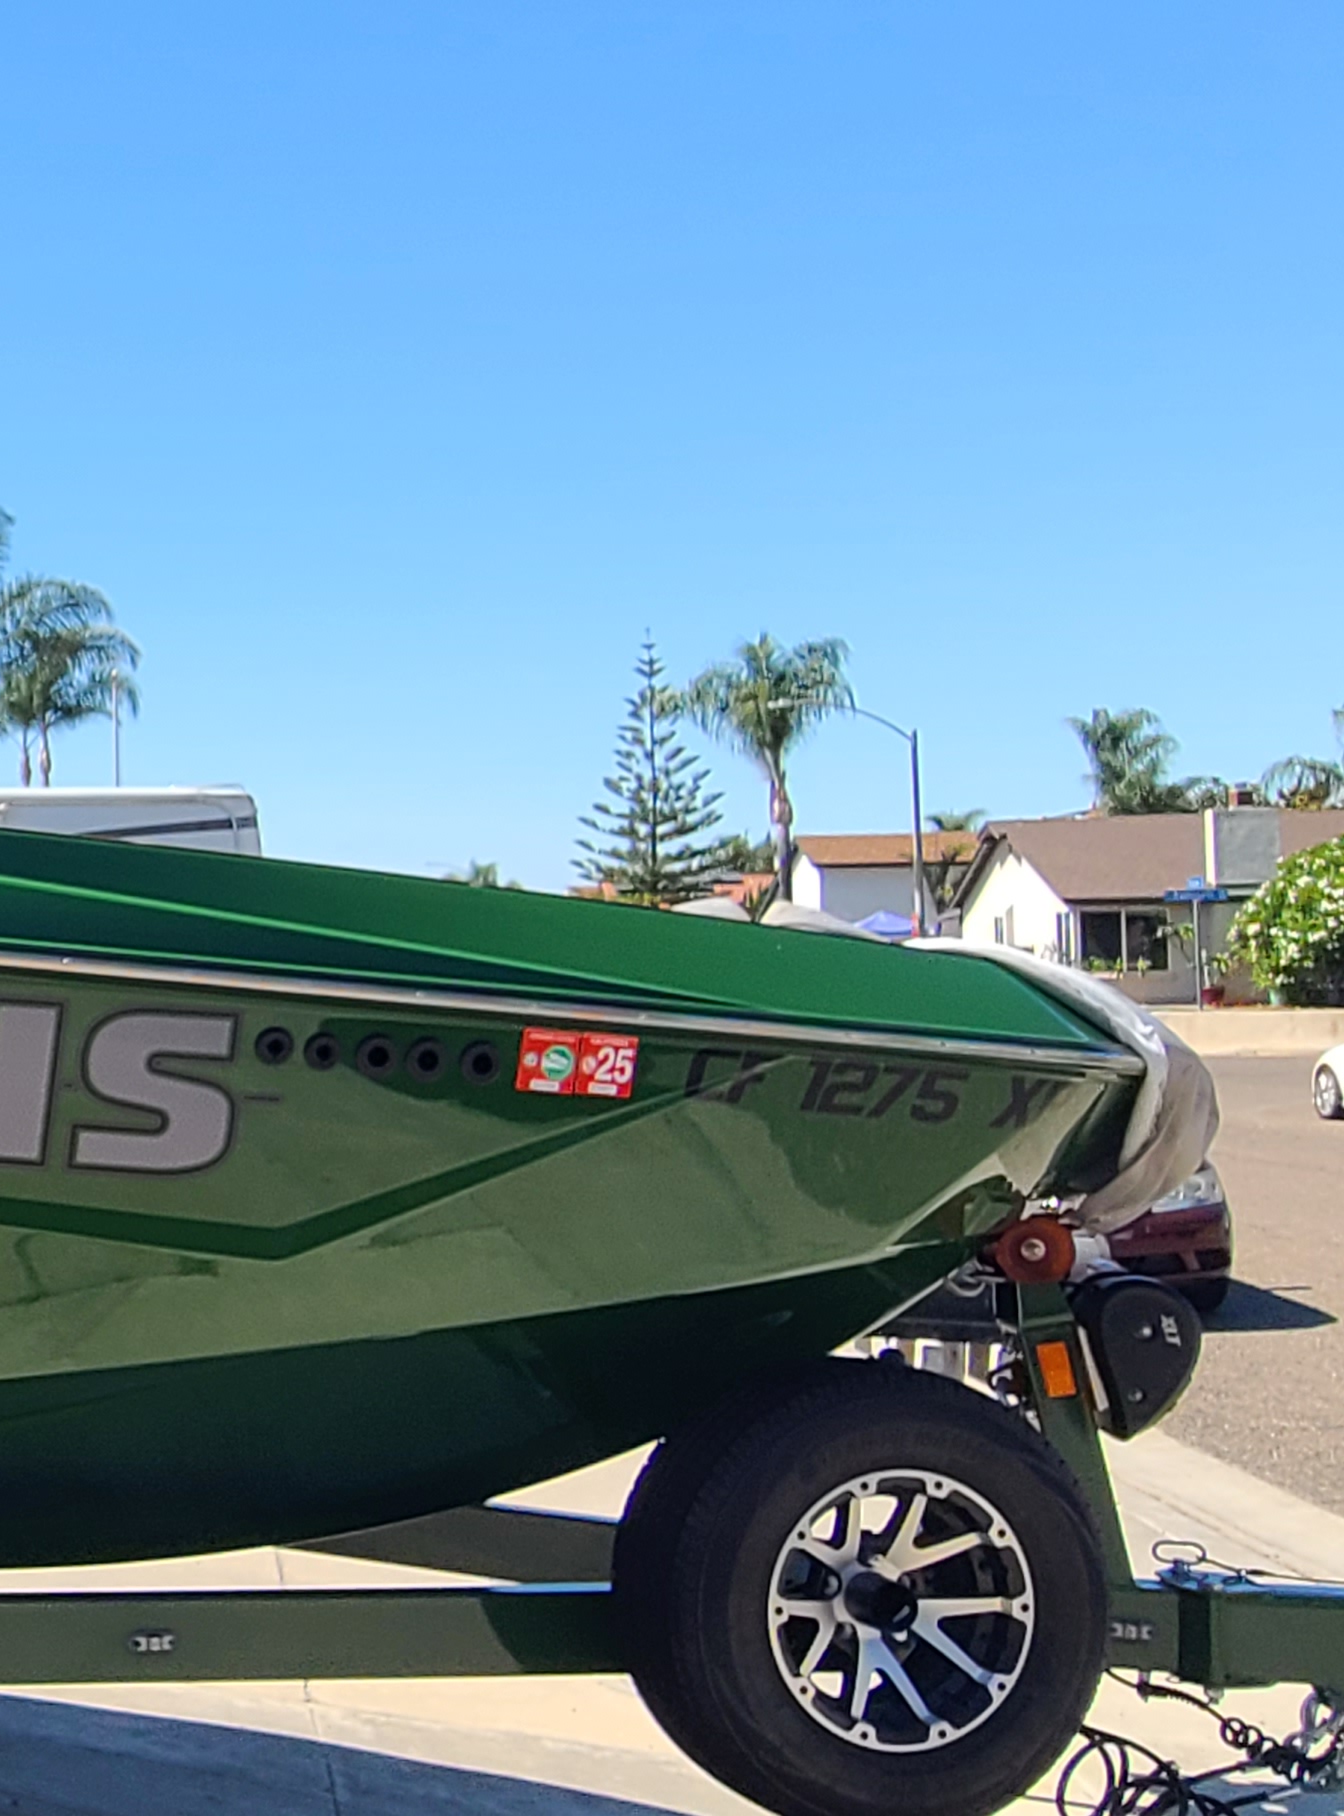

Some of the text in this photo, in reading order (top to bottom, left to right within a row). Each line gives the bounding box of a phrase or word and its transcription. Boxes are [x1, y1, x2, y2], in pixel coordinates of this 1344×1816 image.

[595, 1047, 634, 1083] 25
[684, 1048, 782, 1103] CF
[802, 1059, 968, 1122] 1275
